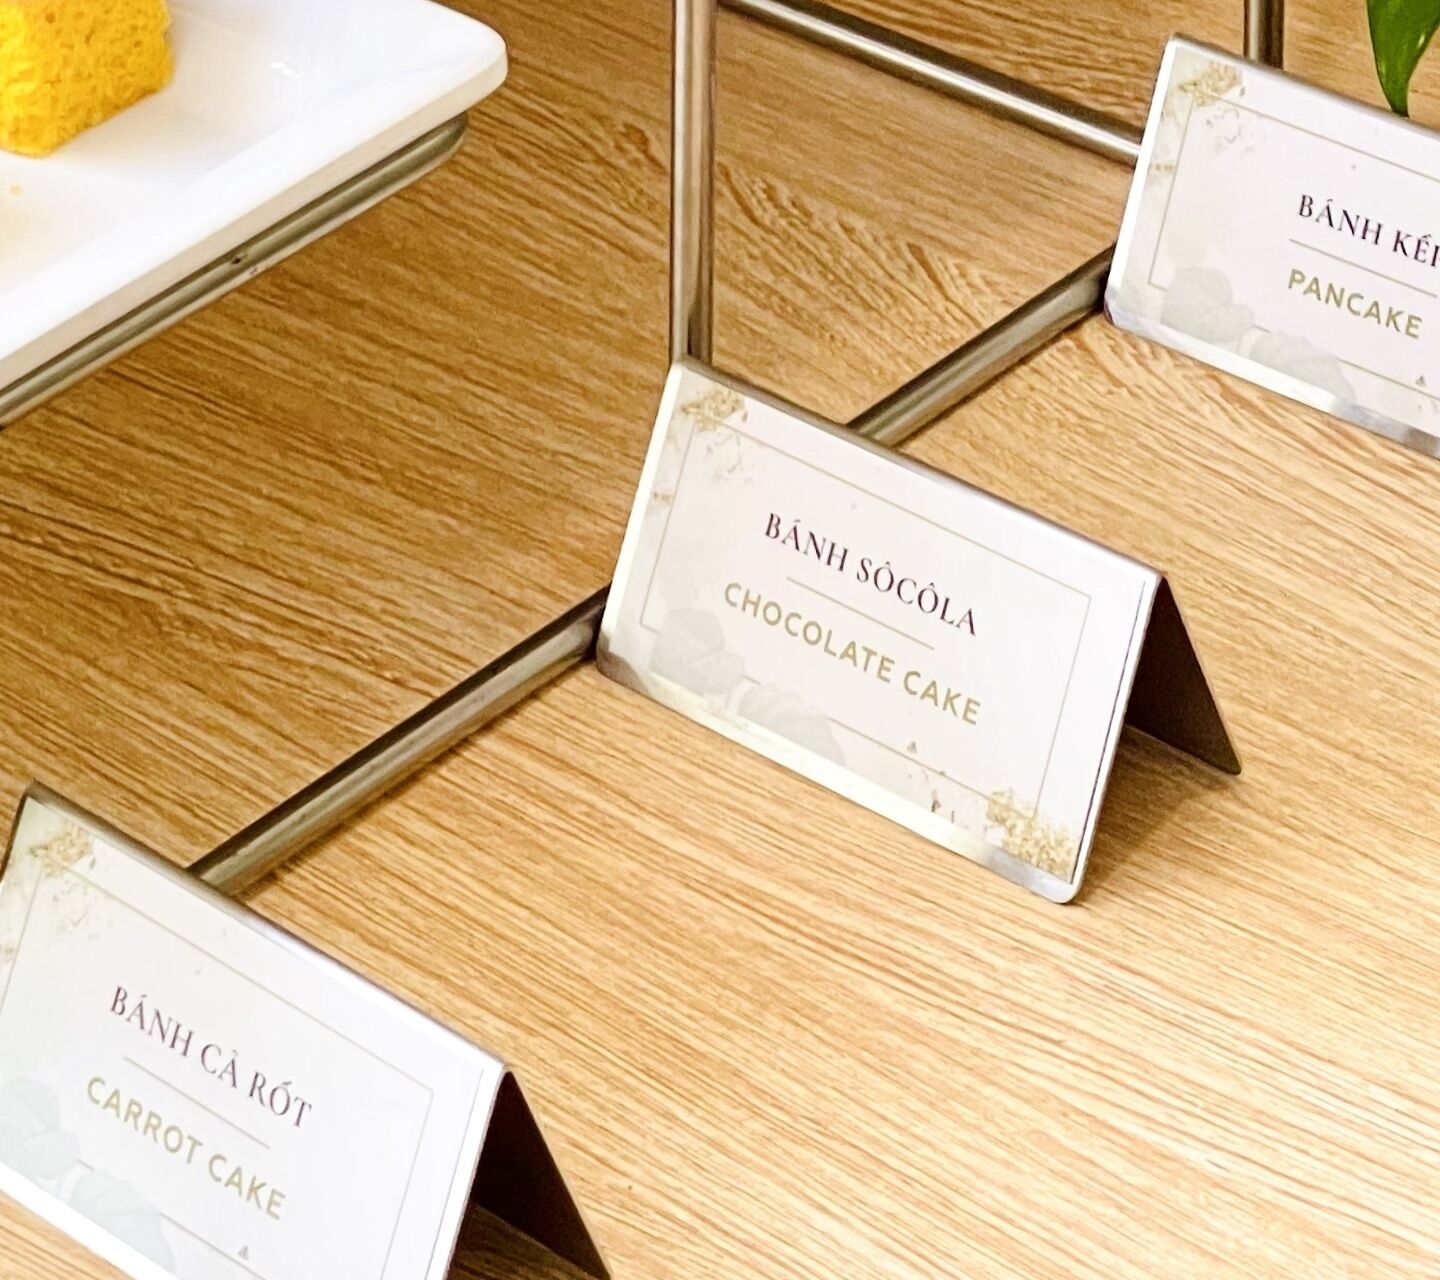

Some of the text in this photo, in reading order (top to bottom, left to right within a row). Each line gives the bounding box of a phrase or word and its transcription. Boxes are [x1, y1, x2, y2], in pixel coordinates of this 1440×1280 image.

[1298, 193, 1383, 246] BÁNH
[1288, 268, 1423, 340] PANCAKE
[765, 513, 976, 637] BÁNH SÔCÔLA
[724, 582, 981, 726] CHOCOLATE CAKE
[110, 986, 194, 1057] BÁNH
[248, 1071, 313, 1128] RỐT
[87, 1076, 286, 1220] CARROT CAKE
